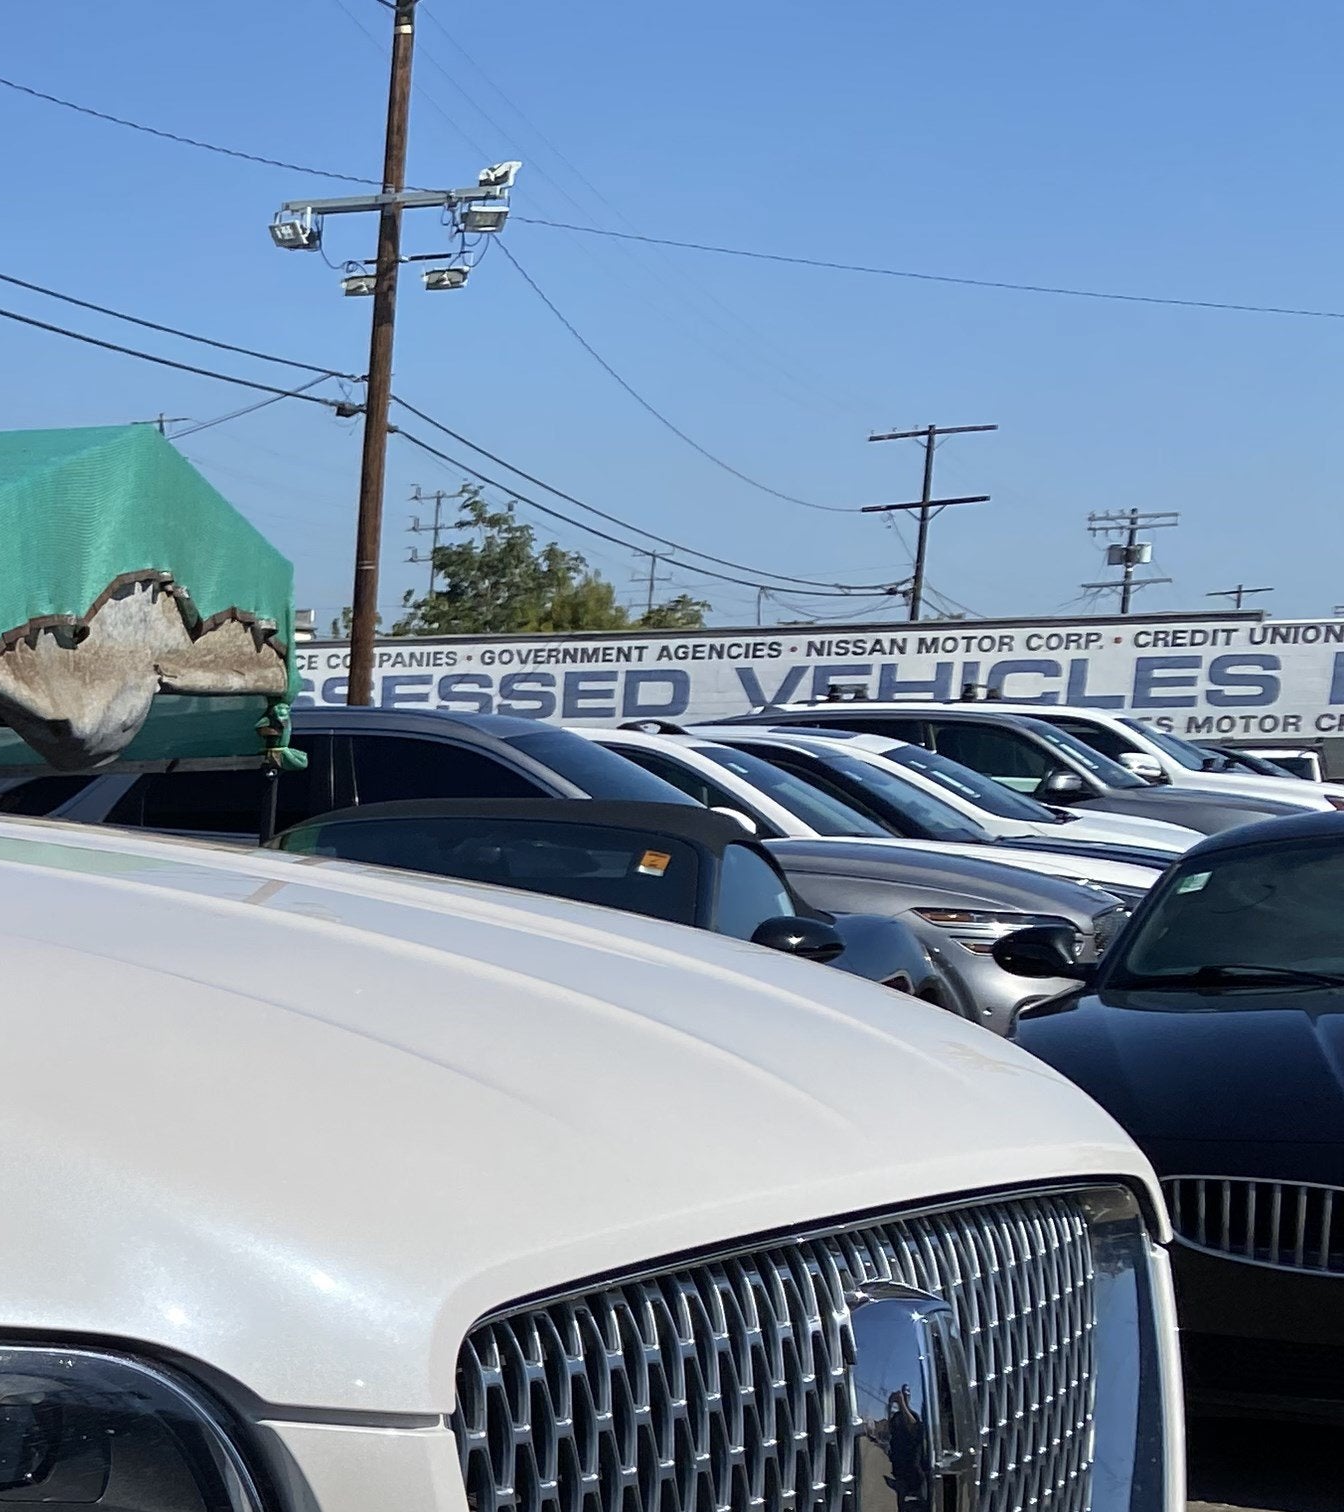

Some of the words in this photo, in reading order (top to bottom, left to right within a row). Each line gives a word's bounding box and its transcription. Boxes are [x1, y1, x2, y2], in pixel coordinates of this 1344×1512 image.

[326, 650, 458, 670] CPANIES
[480, 645, 649, 666] GOVERNMENT
[656, 641, 782, 662] AGENCIES
[806, 636, 909, 657] NISSAN
[917, 633, 1016, 654] MOTOR
[1025, 631, 1104, 652] CORP.
[1134, 627, 1239, 649] CREDIT
[1249, 624, 1344, 646] UNION
[735, 653, 1282, 709] VEHICLES
[1186, 714, 1303, 734] MOTOR
